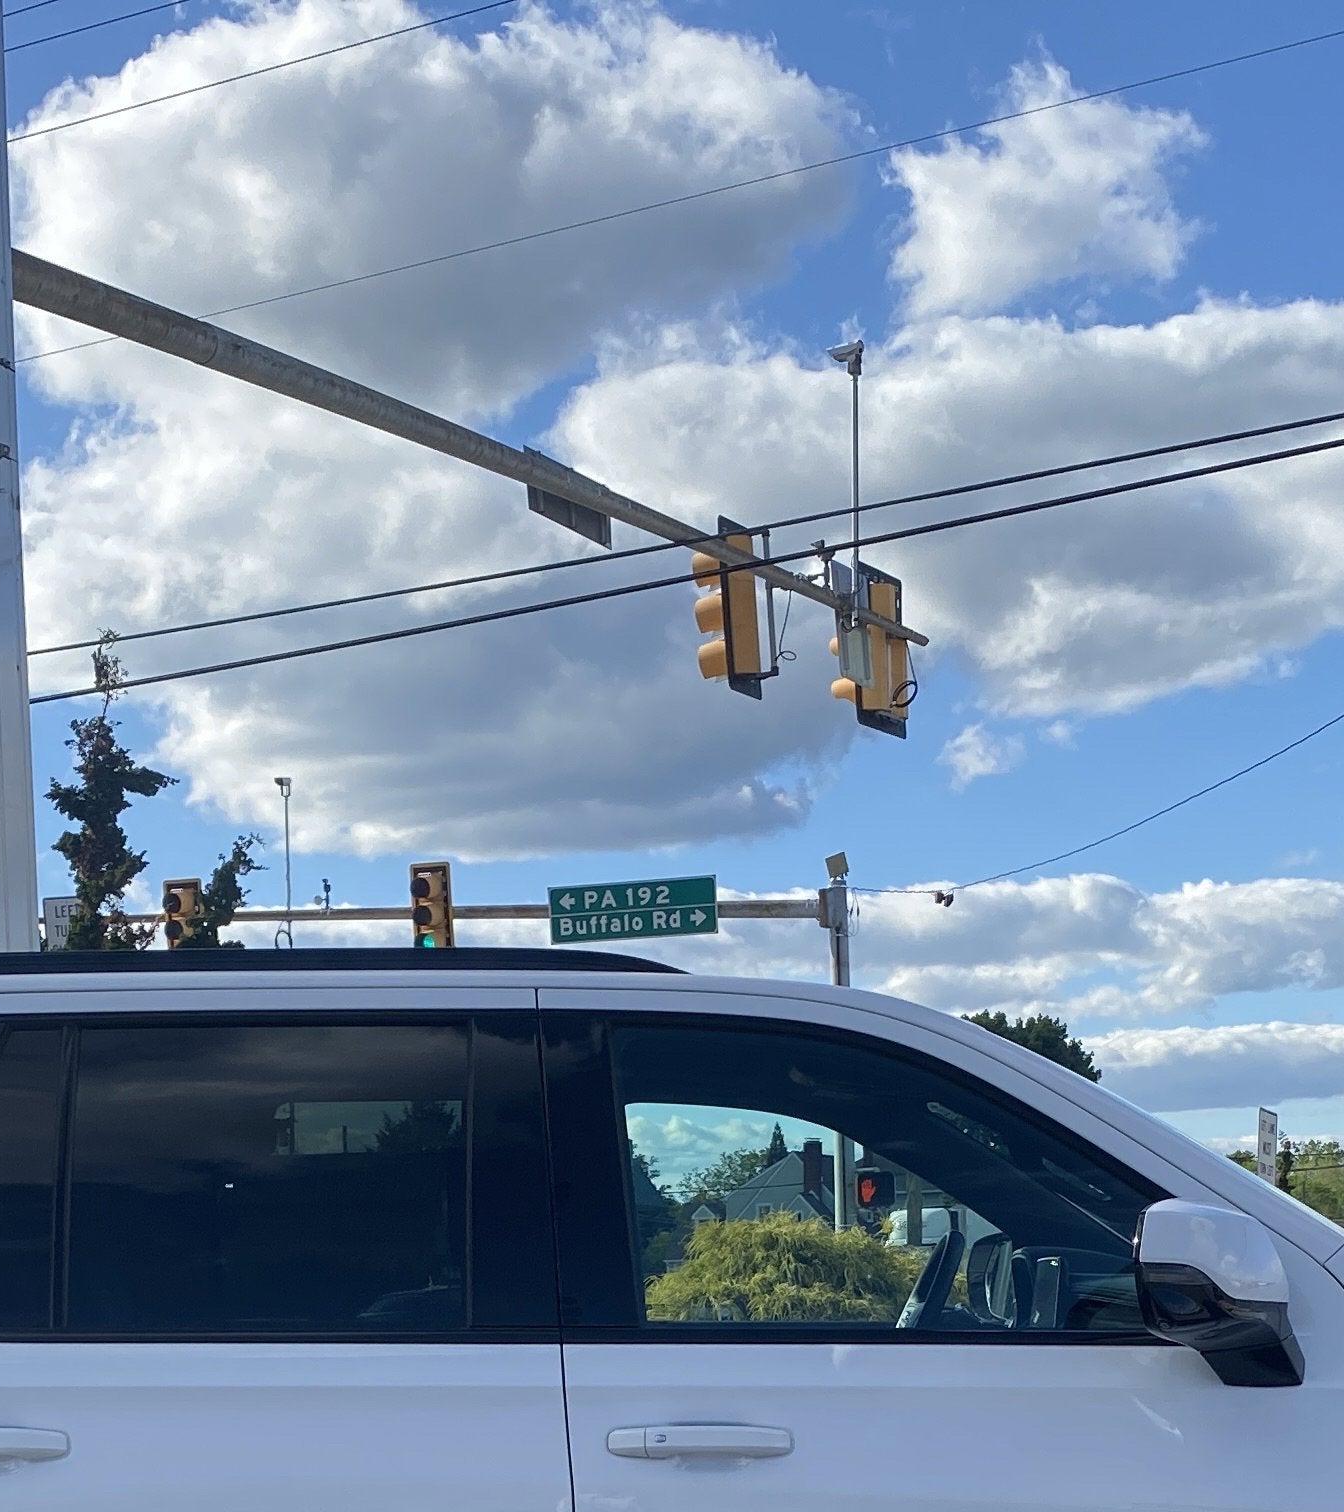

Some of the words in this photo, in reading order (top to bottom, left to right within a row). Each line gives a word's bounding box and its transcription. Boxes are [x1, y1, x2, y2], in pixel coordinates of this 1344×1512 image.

[583, 889, 617, 910] PA
[625, 886, 670, 906] 192
[559, 914, 643, 936] Buffalo
[652, 910, 681, 929] Rd
